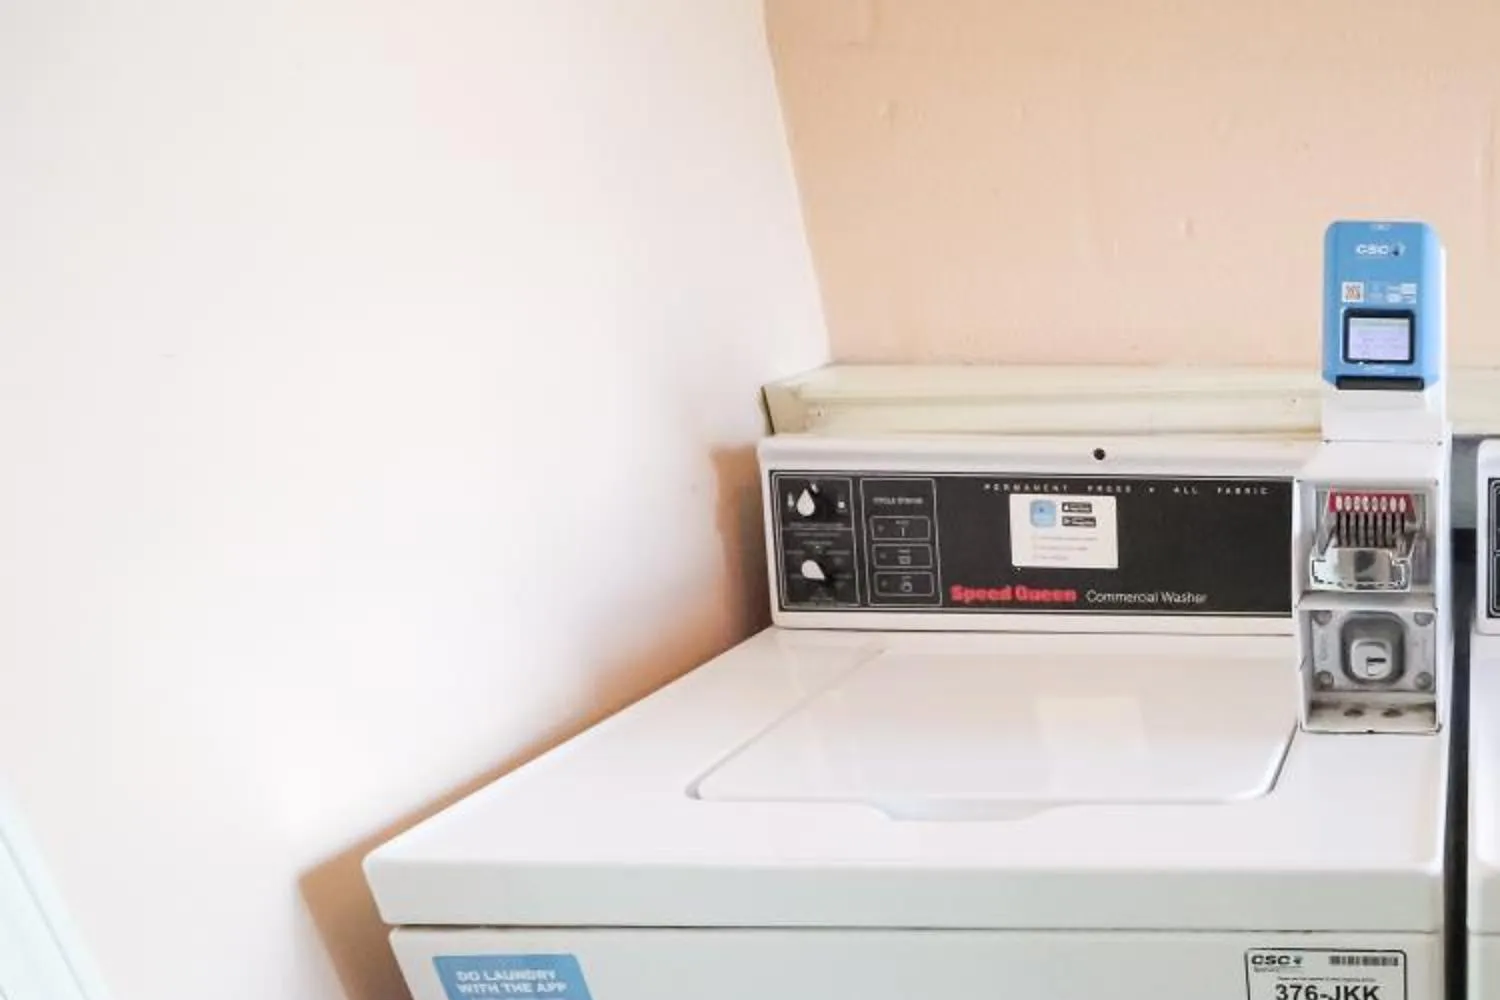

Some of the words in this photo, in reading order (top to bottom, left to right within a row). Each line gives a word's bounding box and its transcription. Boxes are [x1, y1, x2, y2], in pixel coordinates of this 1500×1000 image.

[1173, 486, 1199, 495] ALL
[951, 585, 1012, 604] Speed
[1015, 584, 1078, 602] Queen
[1085, 589, 1158, 603] Commercial
[1160, 590, 1207, 604] Washer
[1251, 955, 1291, 965] CSC
[455, 970, 480, 982] DO
[483, 969, 556, 982] LAUNDRY
[456, 982, 499, 994] WITH
[501, 982, 533, 993] THE
[536, 981, 568, 993] APP
